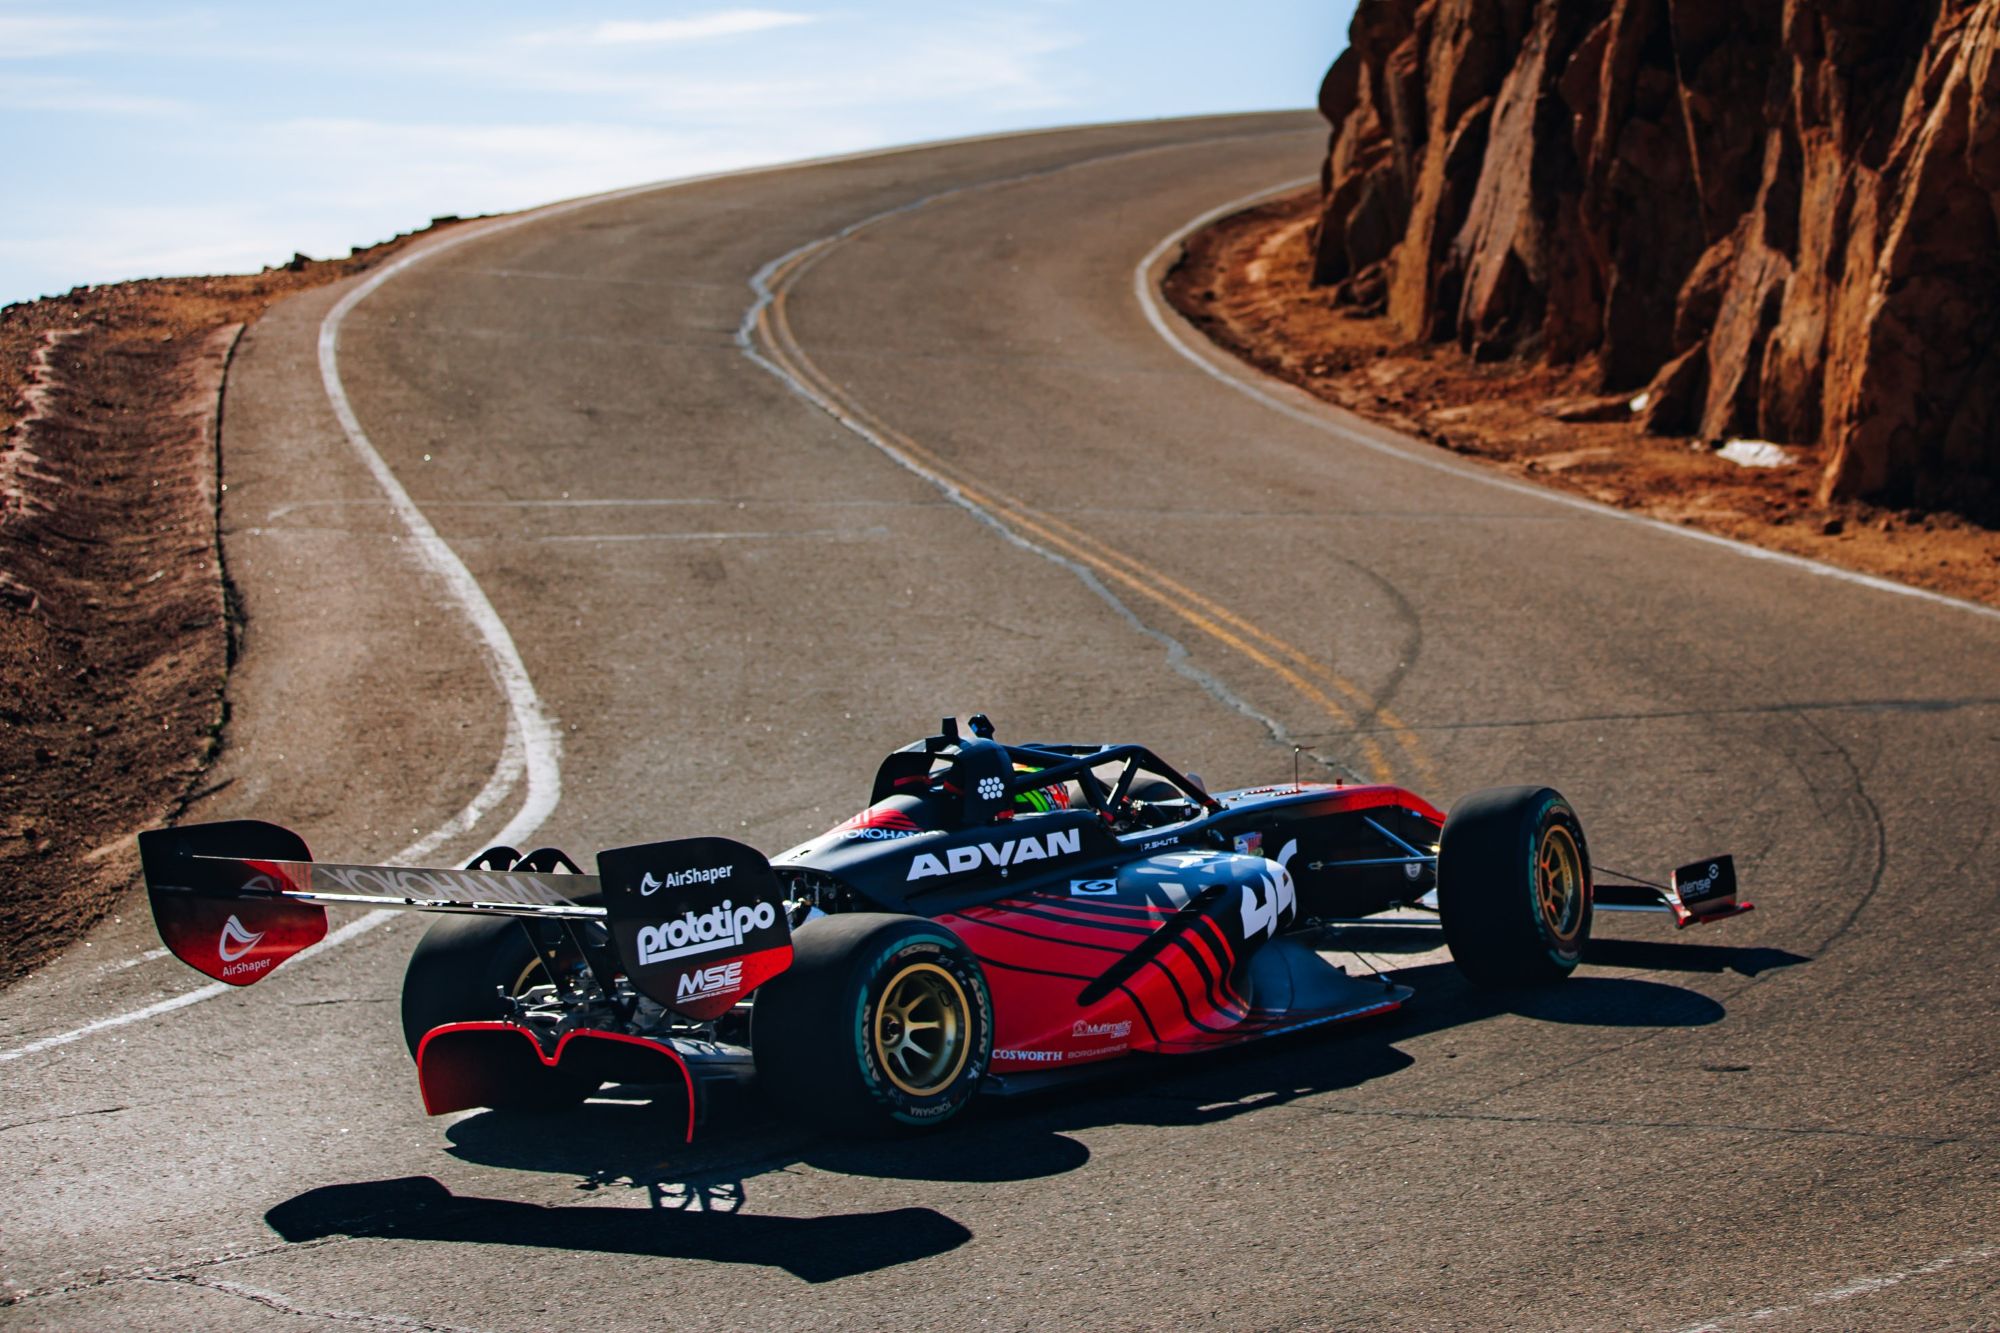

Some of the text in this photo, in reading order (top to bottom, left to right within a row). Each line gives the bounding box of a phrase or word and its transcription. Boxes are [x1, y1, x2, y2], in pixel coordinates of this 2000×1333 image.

[906, 828, 1081, 881] ADVAN
[318, 867, 580, 907] YOKOHAMA
[665, 865, 733, 888] AirShaper
[637, 900, 775, 966] prototipo
[222, 958, 271, 977] AirShaper
[676, 961, 743, 997] MSE
[973, 976, 988, 1053] ADVAN
[863, 1005, 881, 1081] ADVAN
[991, 1049, 1063, 1061] COSWORTH
[910, 1102, 952, 1117] YOKOHAMA
